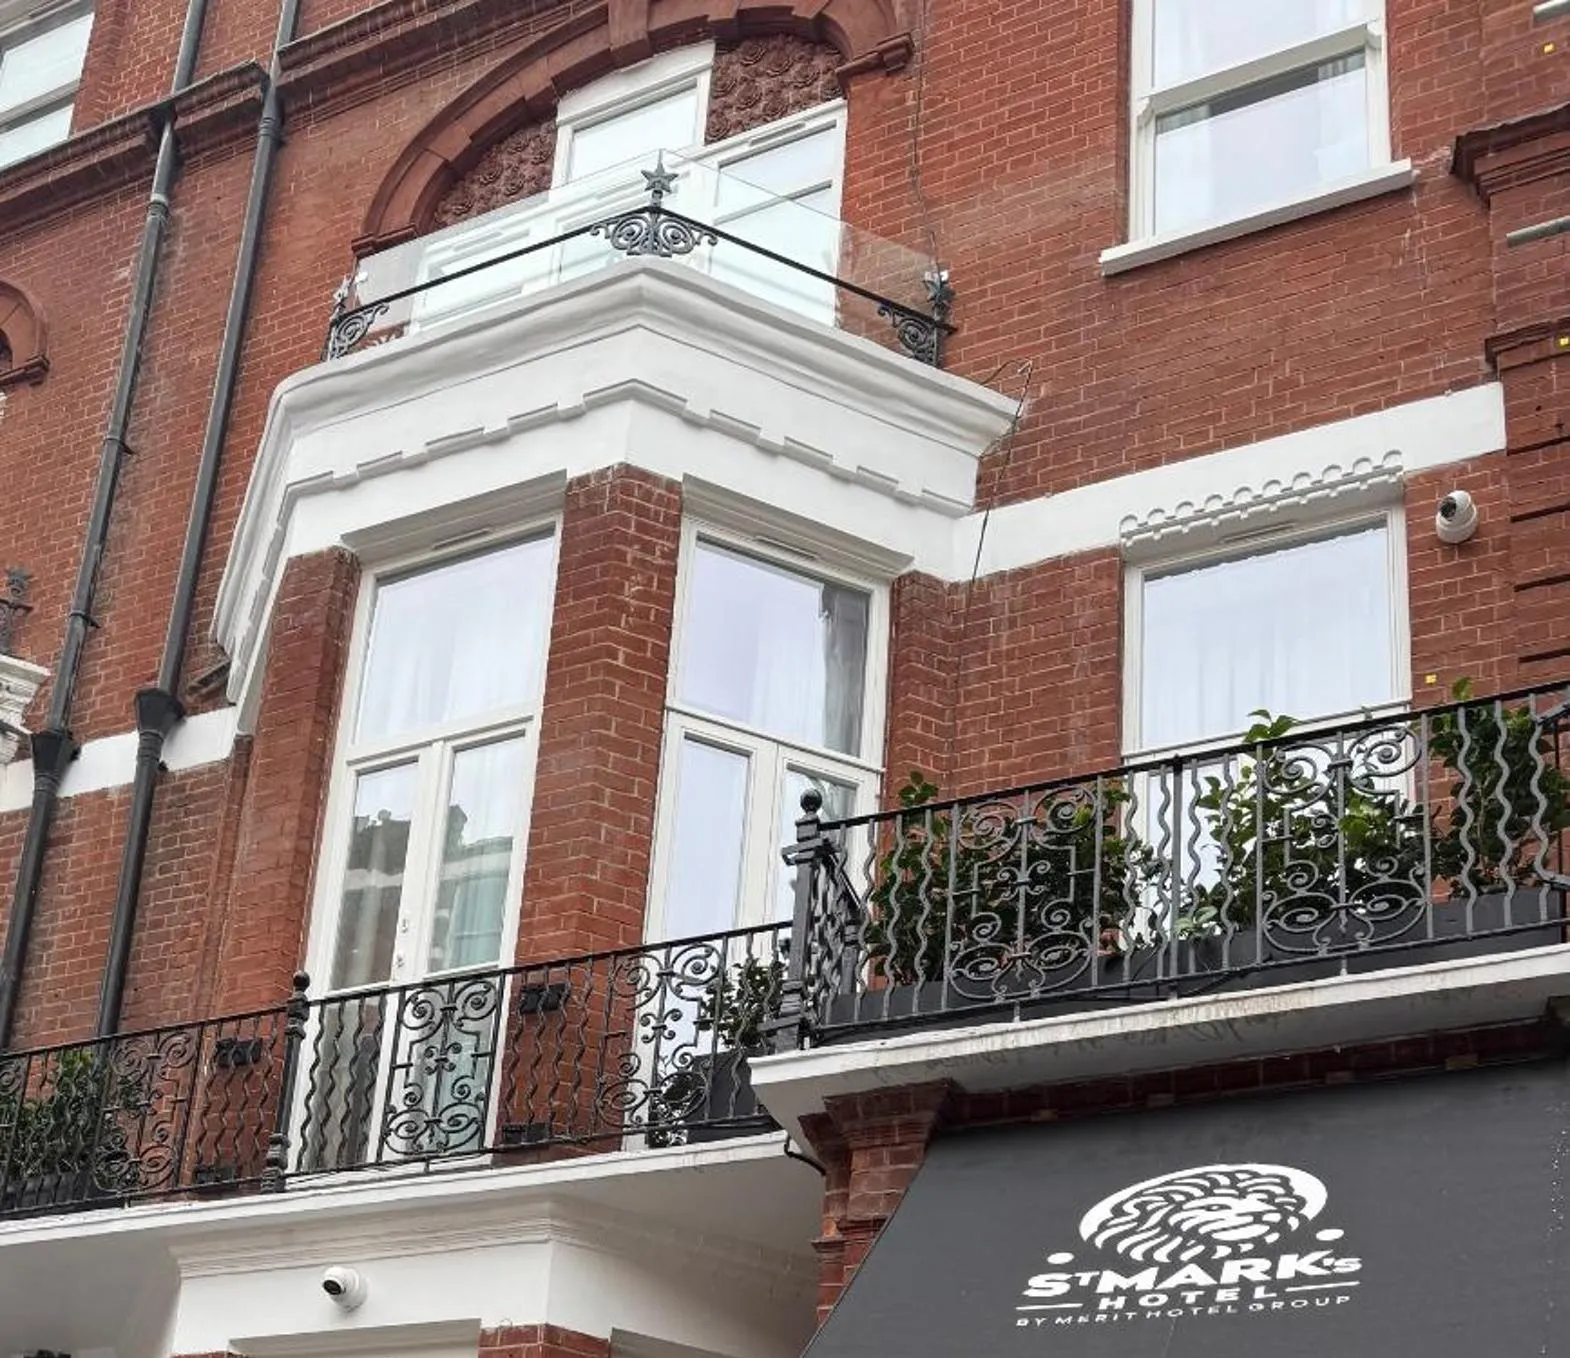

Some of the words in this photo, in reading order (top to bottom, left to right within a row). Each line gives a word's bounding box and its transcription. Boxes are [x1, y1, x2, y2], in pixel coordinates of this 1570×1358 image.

[1015, 1317, 1047, 1327] BY
[1054, 1311, 1138, 1325] MERIT
[1145, 1304, 1238, 1319] HOTEL
[1248, 1295, 1351, 1312] GROUP
[1098, 1285, 1278, 1310] HOTEL
